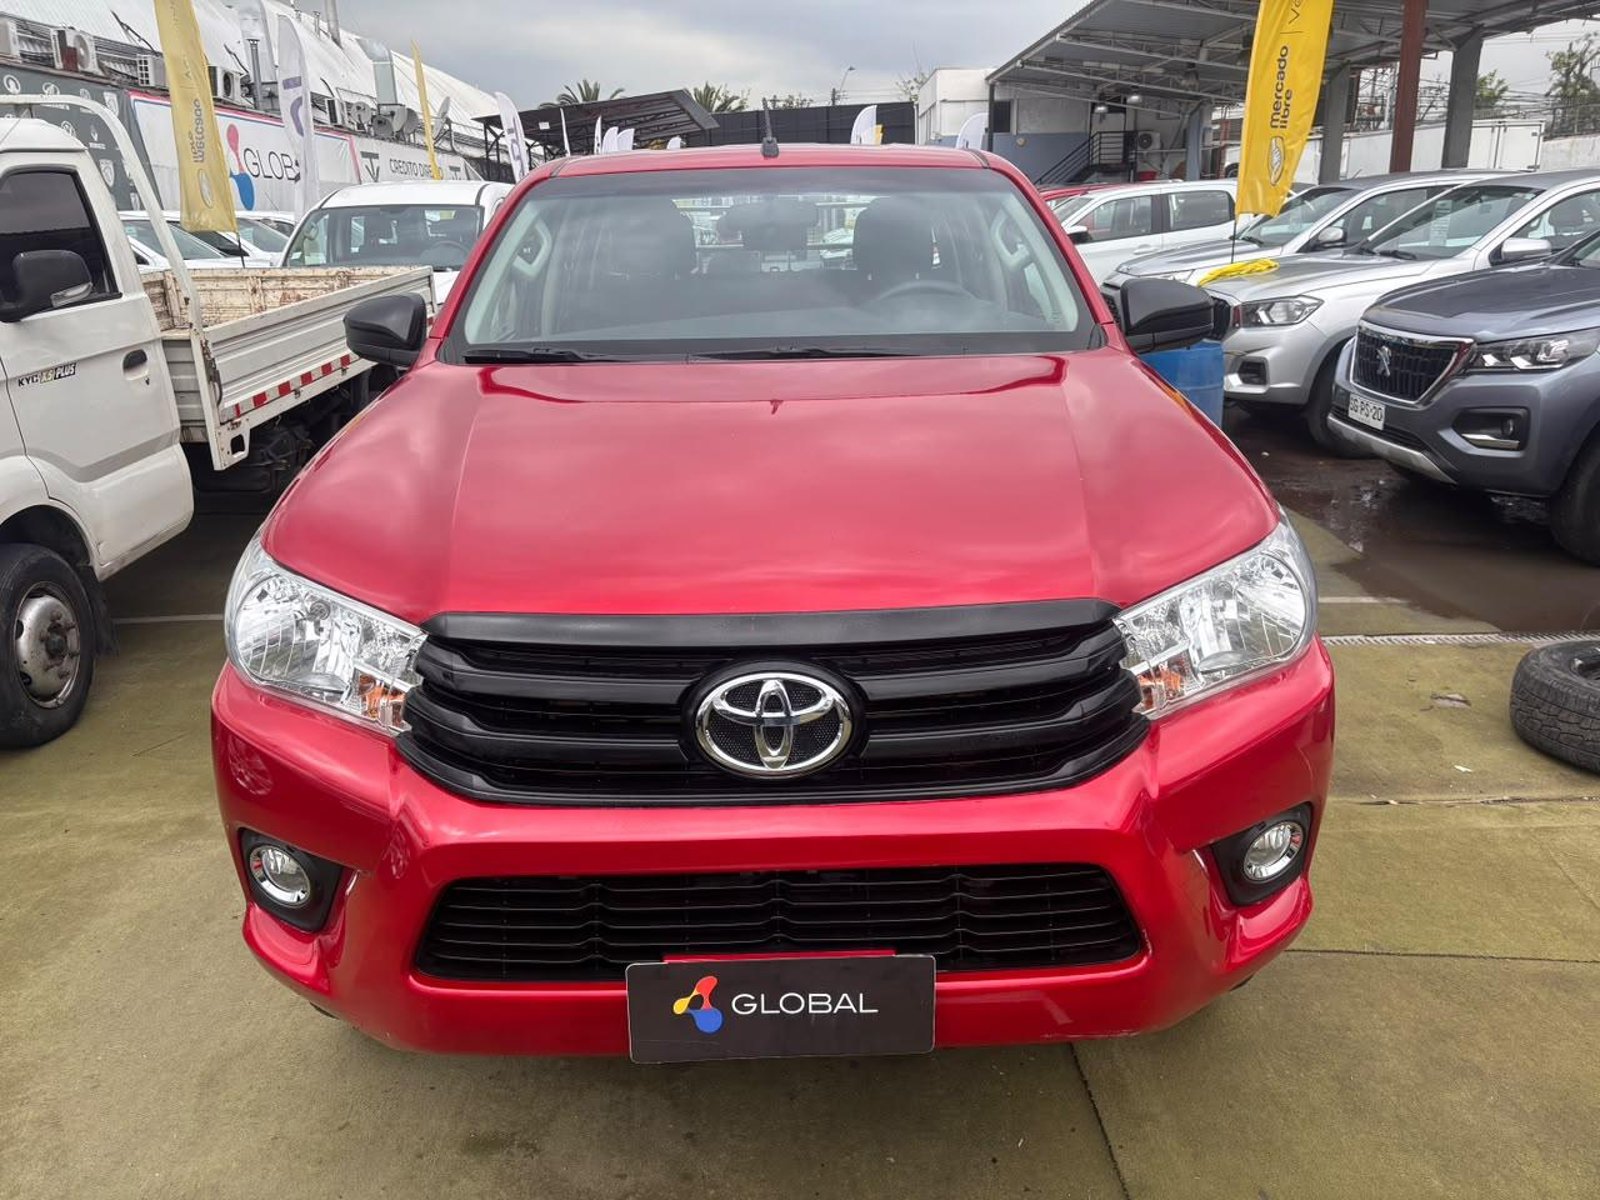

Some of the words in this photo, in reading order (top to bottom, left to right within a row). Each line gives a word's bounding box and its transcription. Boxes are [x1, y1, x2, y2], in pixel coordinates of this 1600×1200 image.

[1270, 45, 1289, 129] mercado
[1279, 89, 1293, 129] libre
[243, 148, 301, 183] GLOB
[54, 362, 76, 380] PLUS
[731, 992, 879, 1015] GLOBAL
